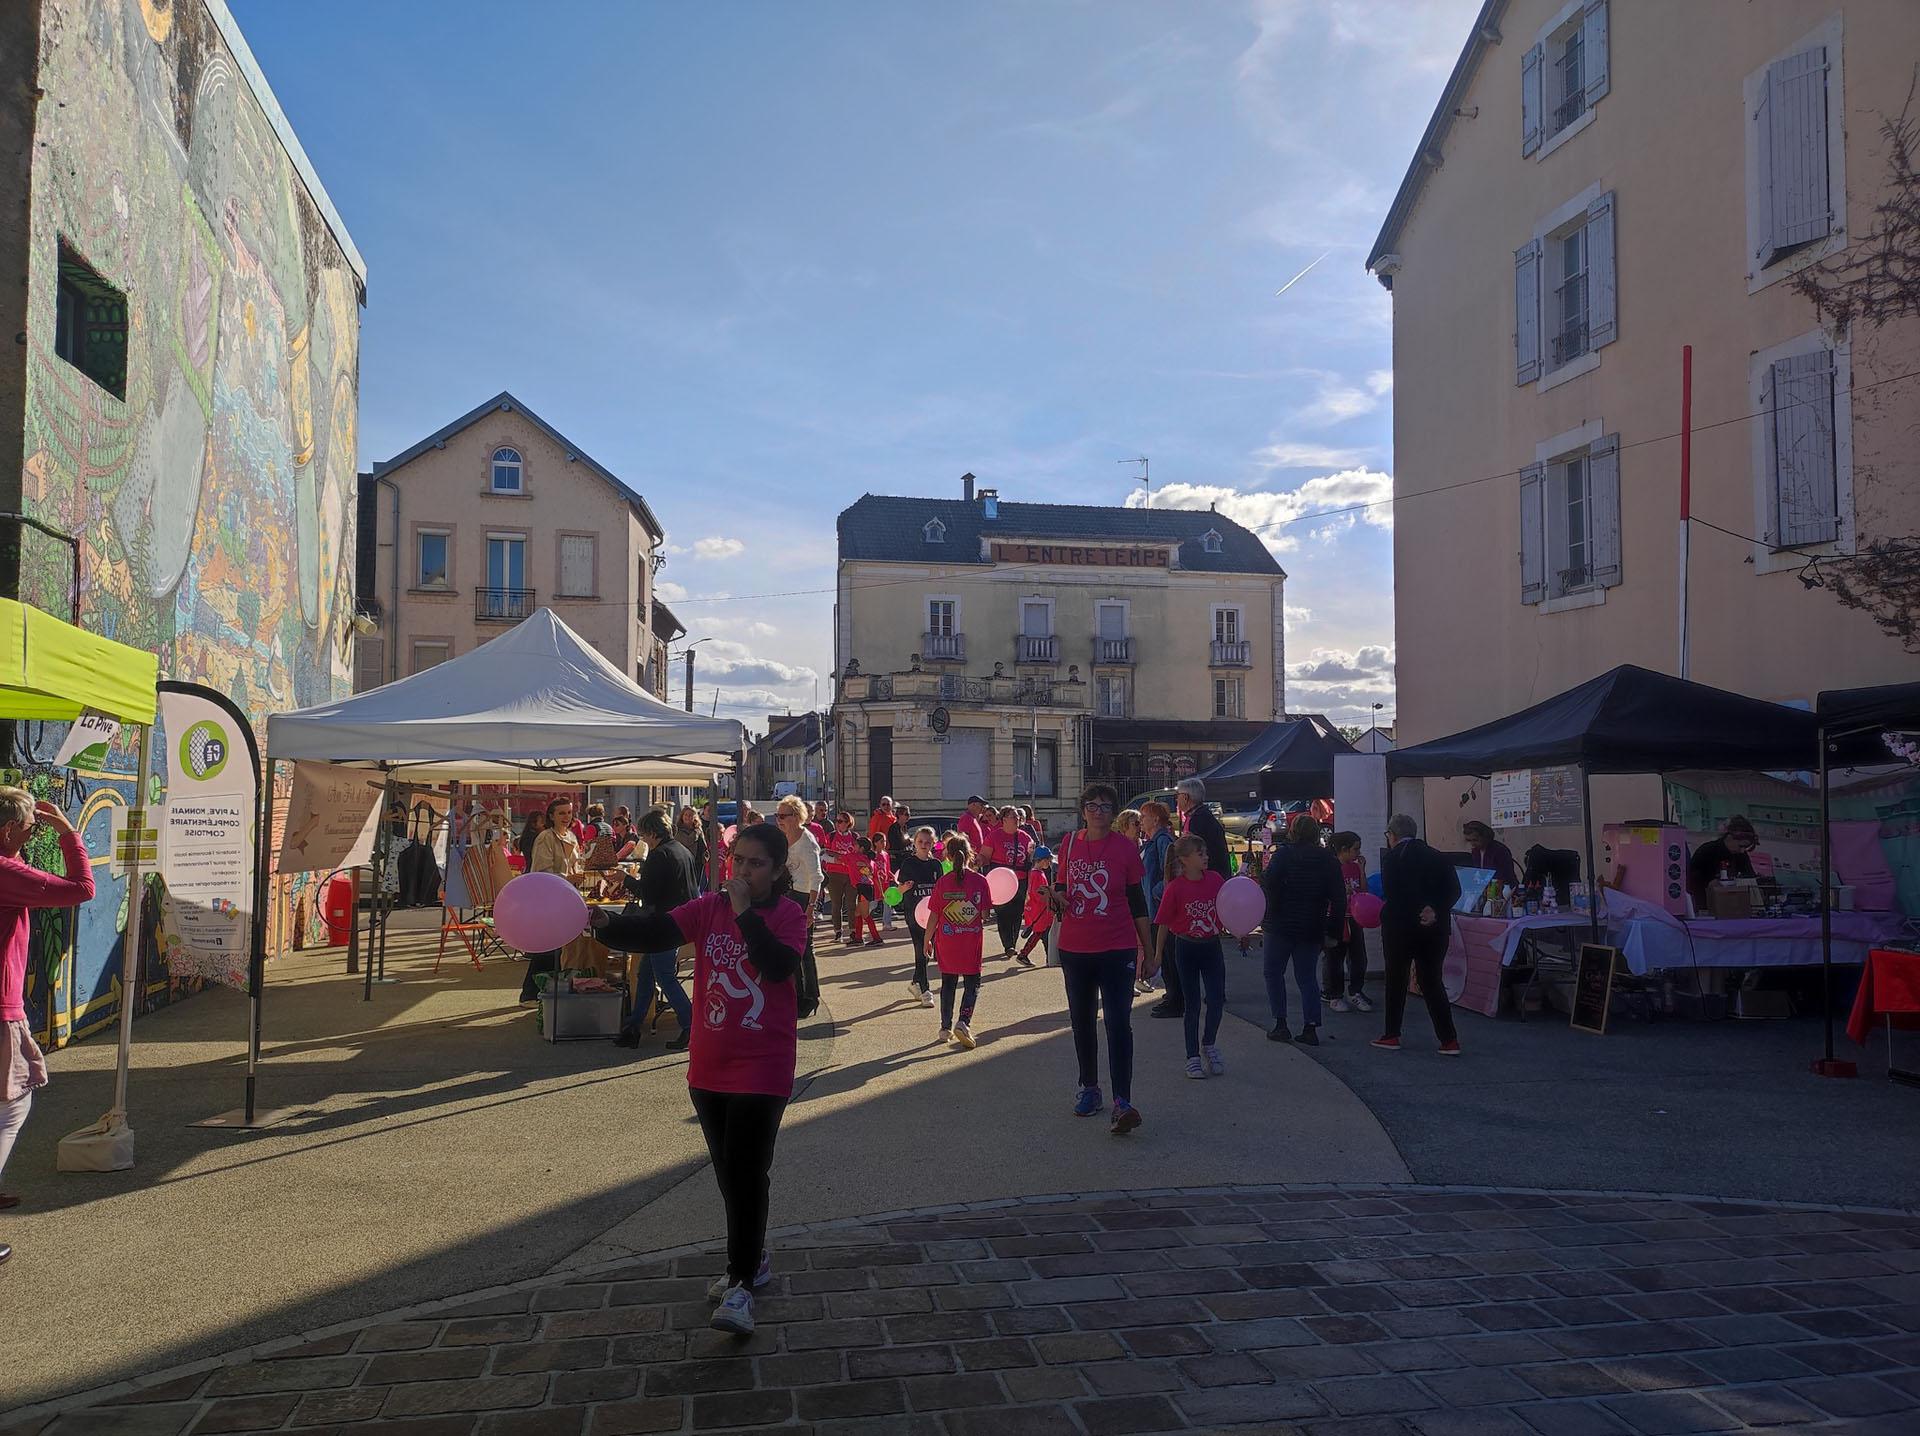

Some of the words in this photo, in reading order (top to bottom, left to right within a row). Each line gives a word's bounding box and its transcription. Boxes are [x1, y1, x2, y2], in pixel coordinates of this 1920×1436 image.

[80, 712, 96, 729] La
[95, 716, 113, 733] Pive
[961, 907, 976, 915] SGE
[705, 945, 736, 969] ROSE
